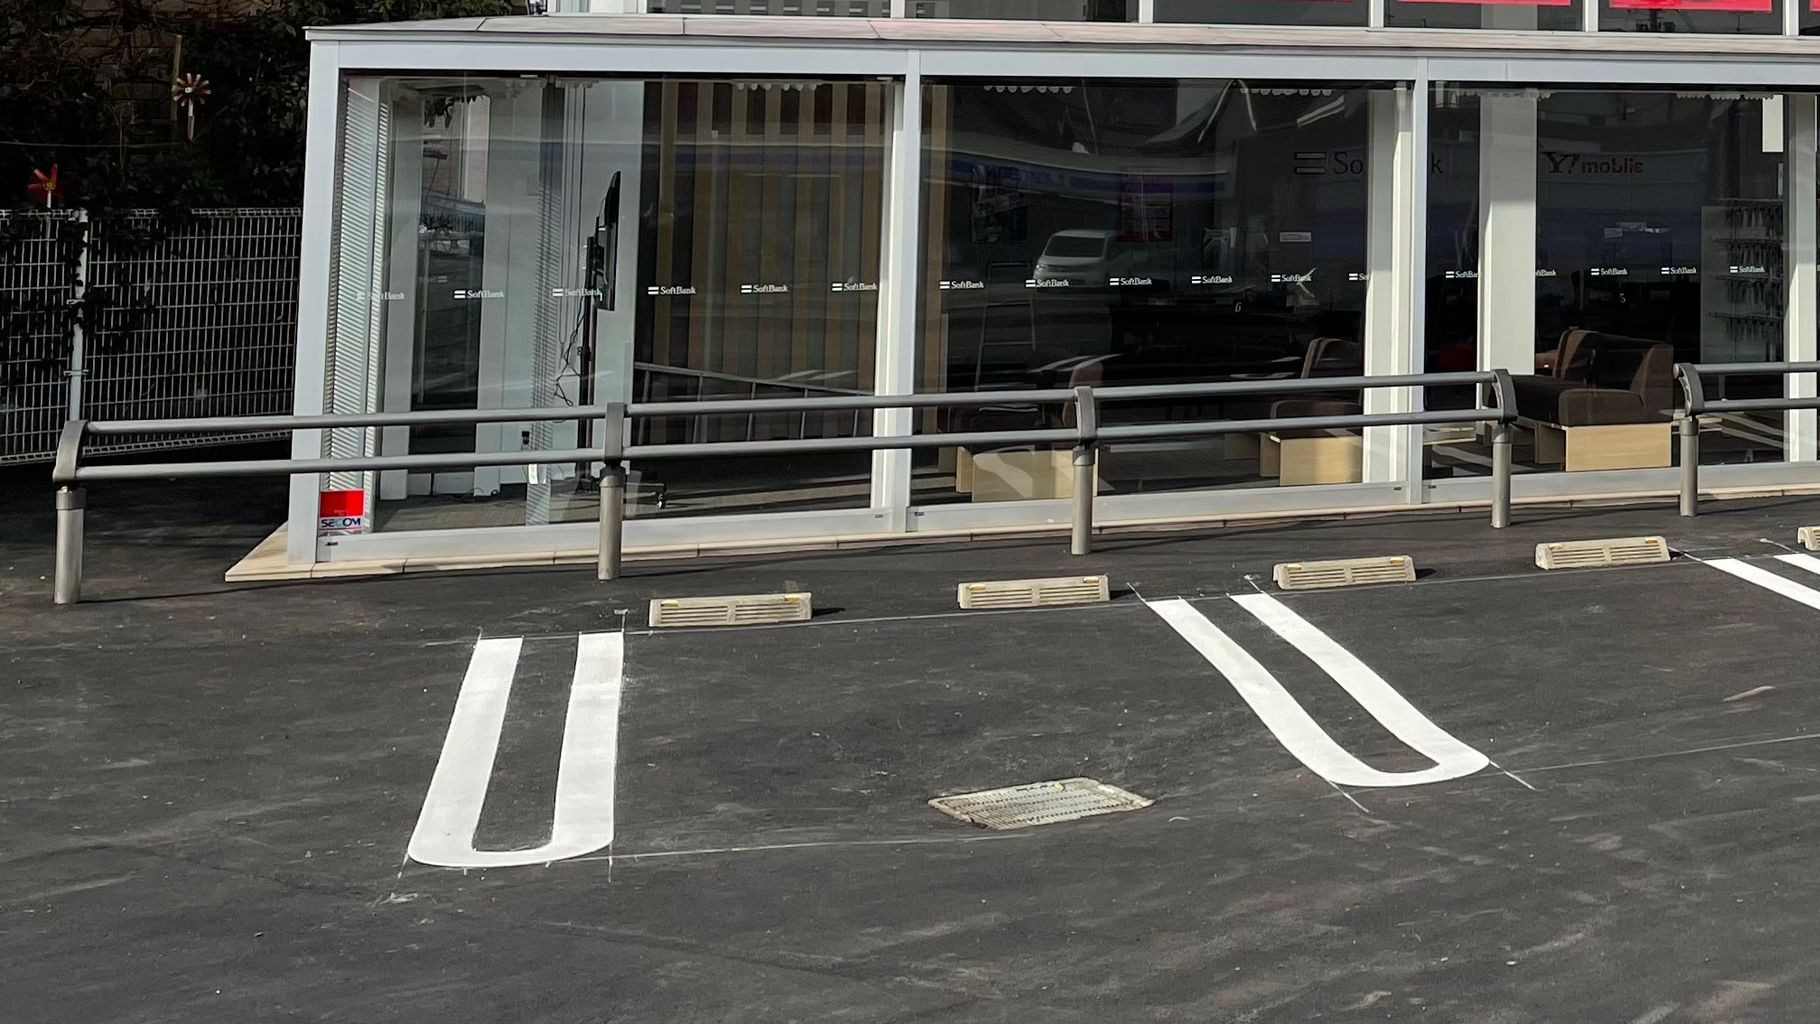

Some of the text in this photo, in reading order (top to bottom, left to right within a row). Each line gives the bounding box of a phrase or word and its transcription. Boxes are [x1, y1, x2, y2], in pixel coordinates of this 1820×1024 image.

[1600, 268, 1628, 276] SoftBank
[1670, 266, 1697, 274] SoftBank
[1037, 279, 1070, 287] SoftBank
[1120, 277, 1153, 285] SoftBank
[1202, 275, 1233, 284] SoftBank
[753, 284, 789, 293] SoftBank
[843, 282, 877, 291] SoftBank
[951, 280, 985, 289] SoftBank
[467, 289, 505, 299] SoftBank
[660, 286, 696, 295] SoftBank
